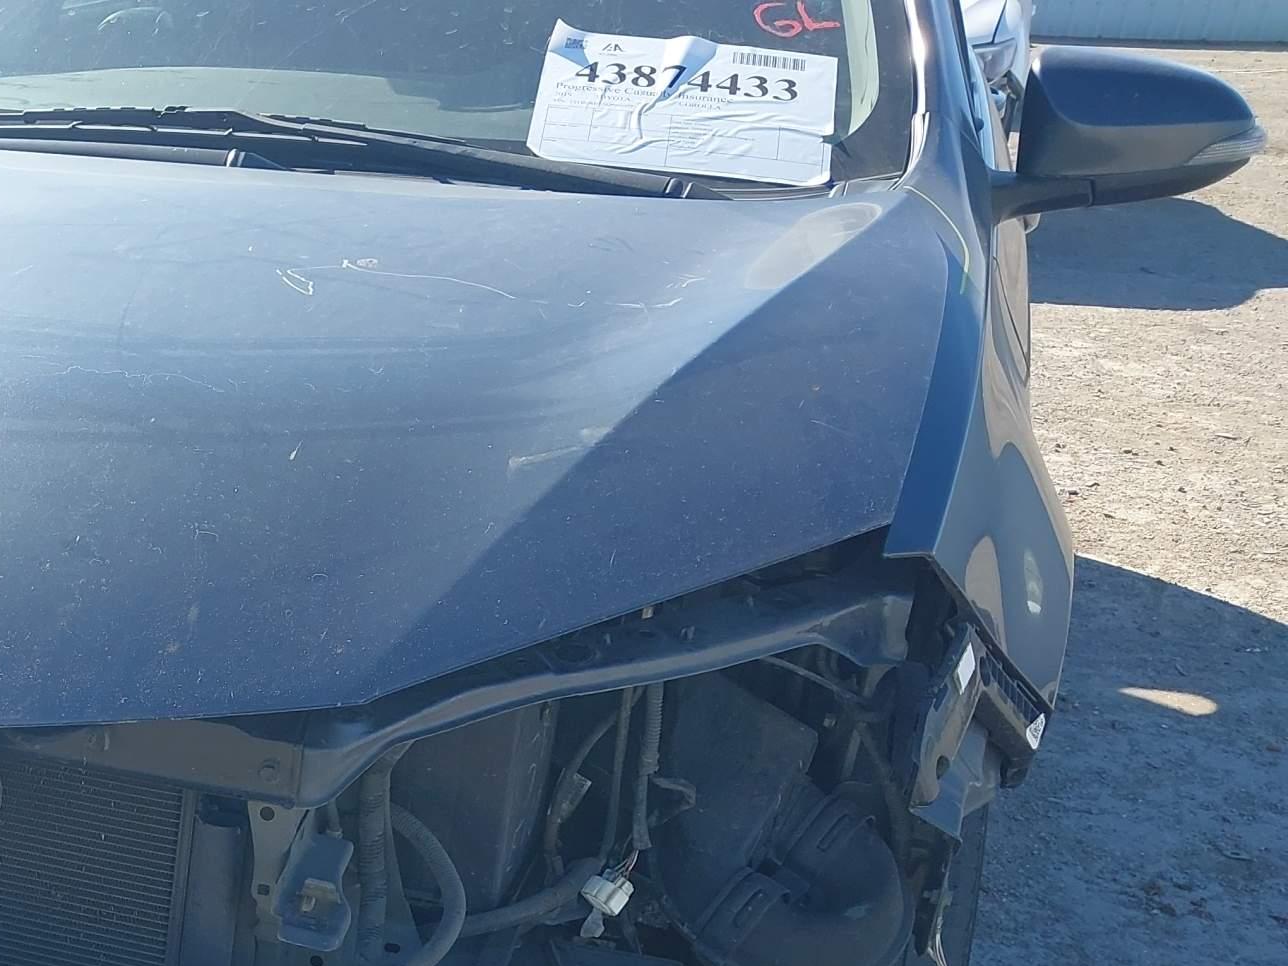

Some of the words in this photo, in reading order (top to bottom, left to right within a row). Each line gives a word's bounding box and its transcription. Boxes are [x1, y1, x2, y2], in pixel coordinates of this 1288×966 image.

[556, 81, 621, 95] Progressive
[678, 90, 734, 104] Insurance
[575, 60, 799, 102] 43874433
